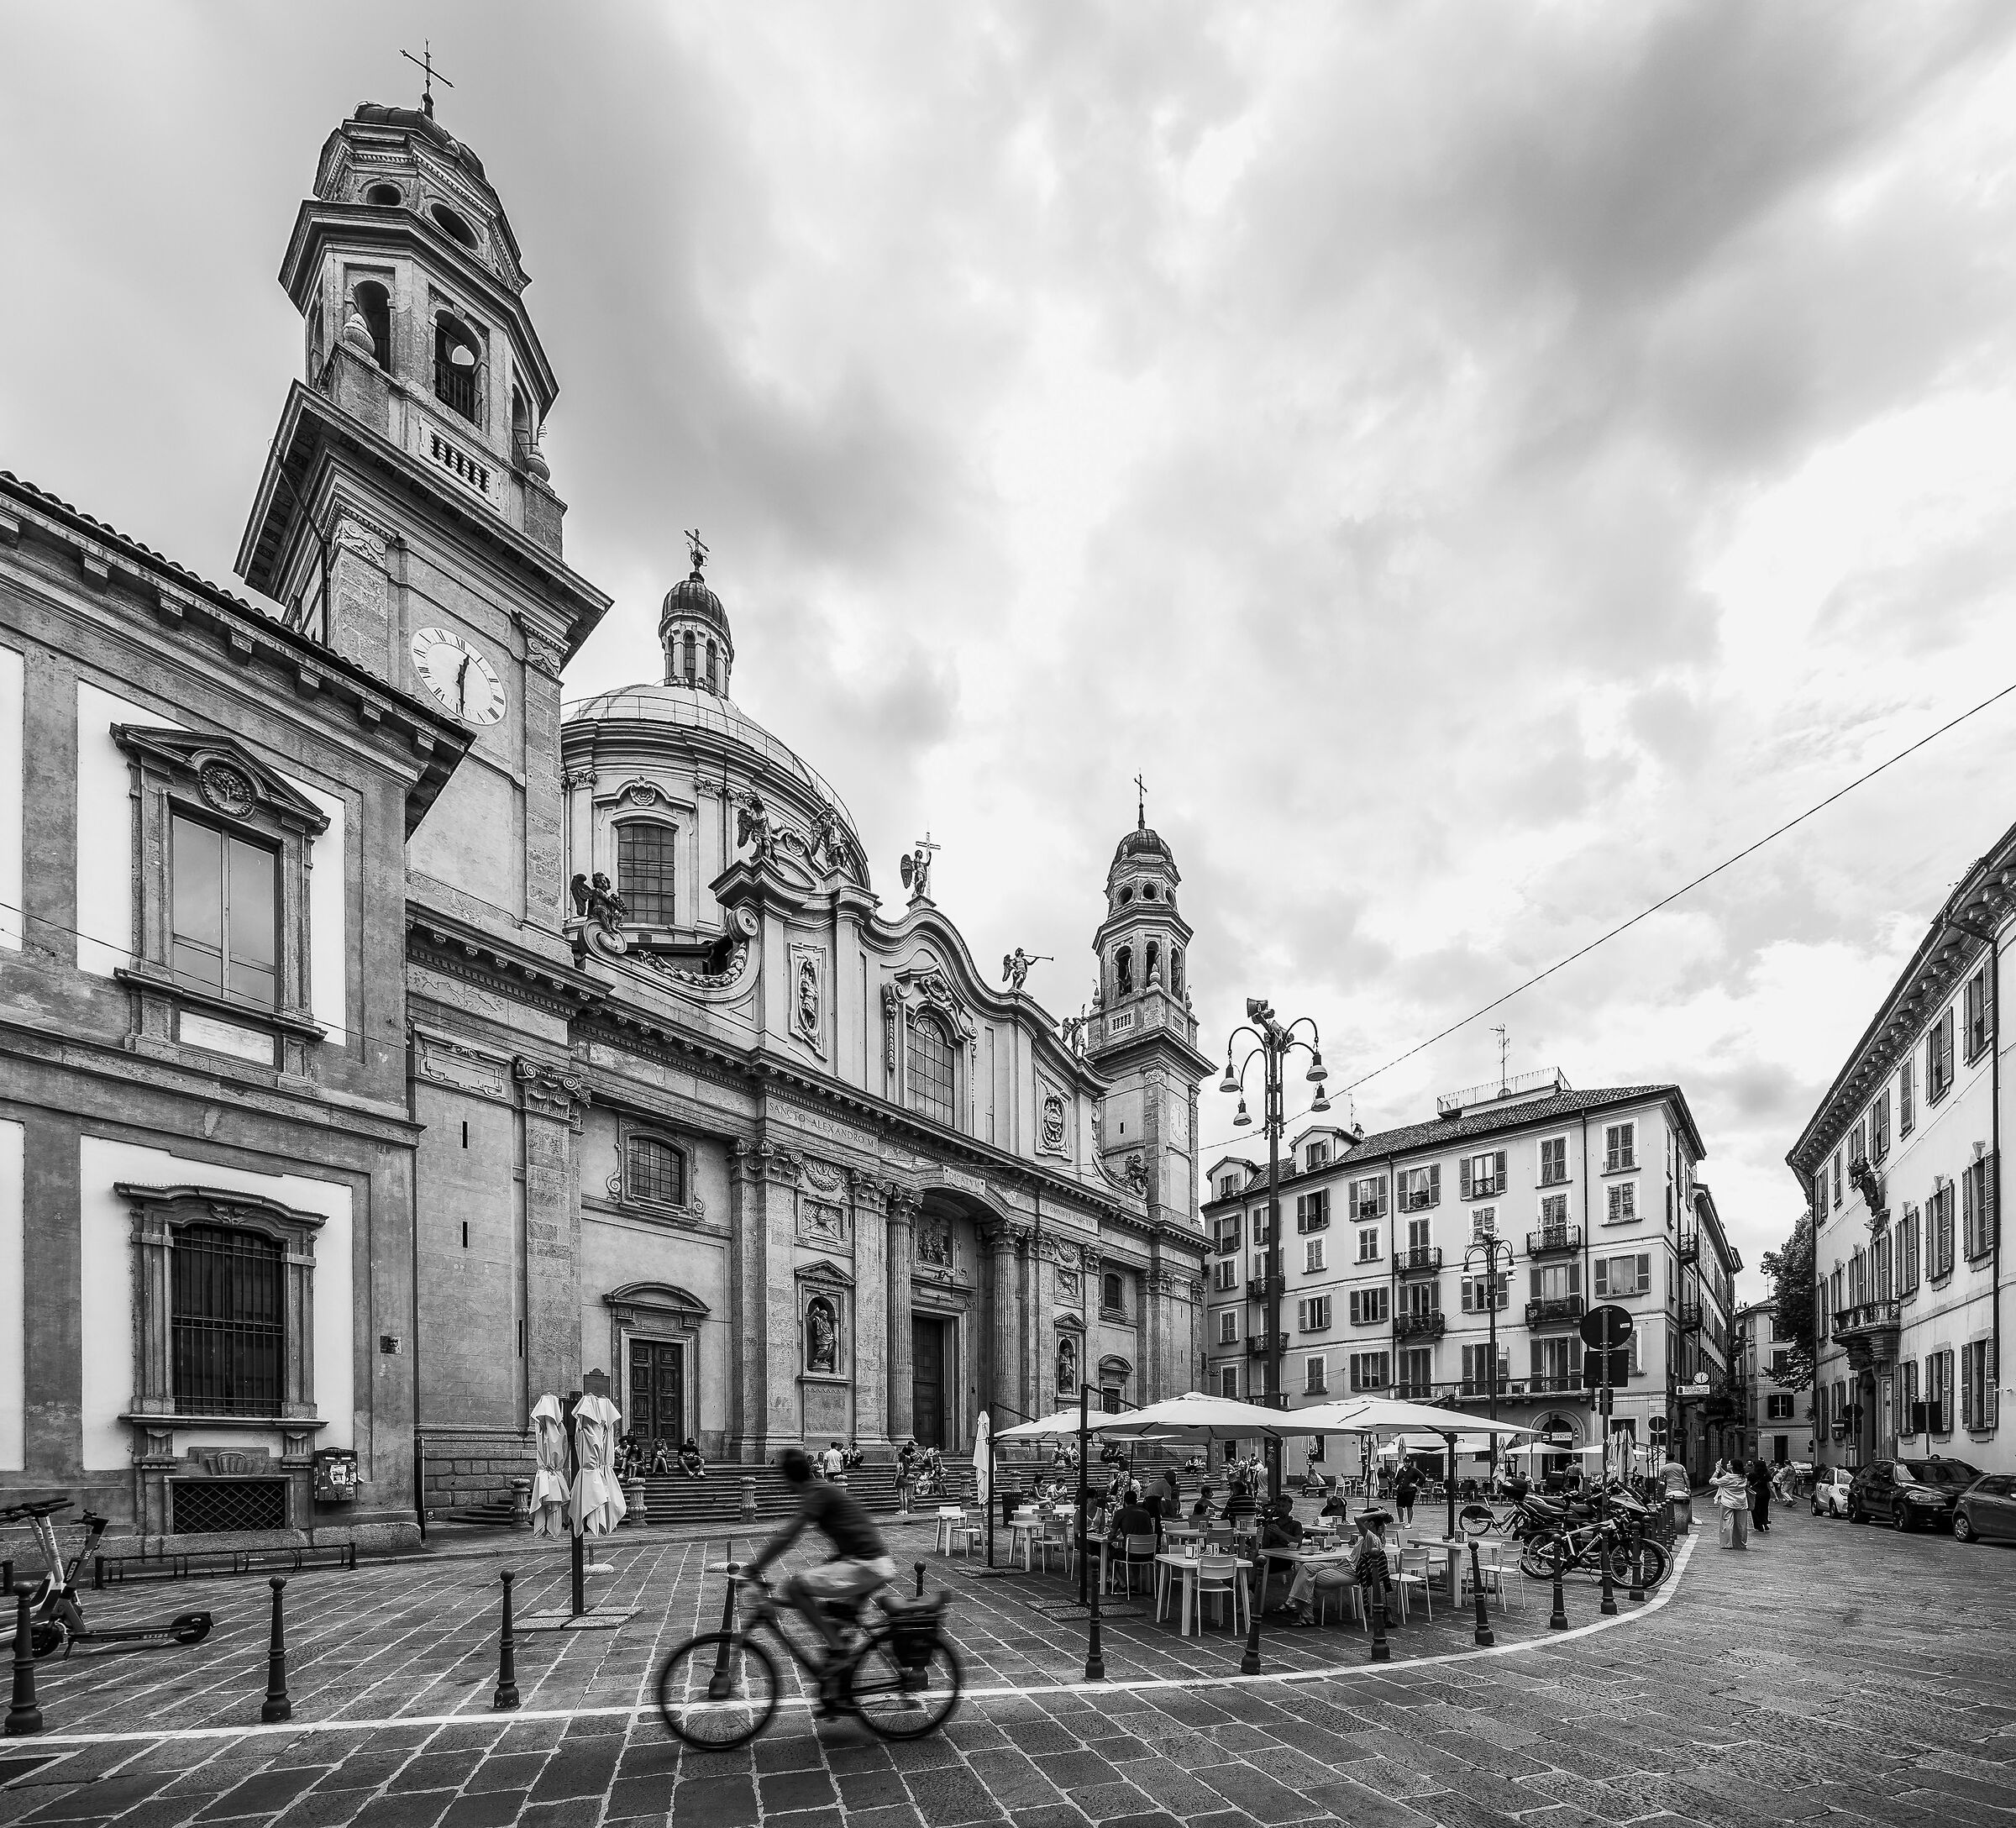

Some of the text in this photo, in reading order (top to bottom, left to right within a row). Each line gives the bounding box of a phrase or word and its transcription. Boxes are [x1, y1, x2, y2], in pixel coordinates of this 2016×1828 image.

[769, 1102, 806, 1122] SANCTO
[811, 1119, 864, 1144] ALEXANDRO
[948, 1171, 980, 1190] DICATVM
[1042, 1203, 1048, 1211] ET
